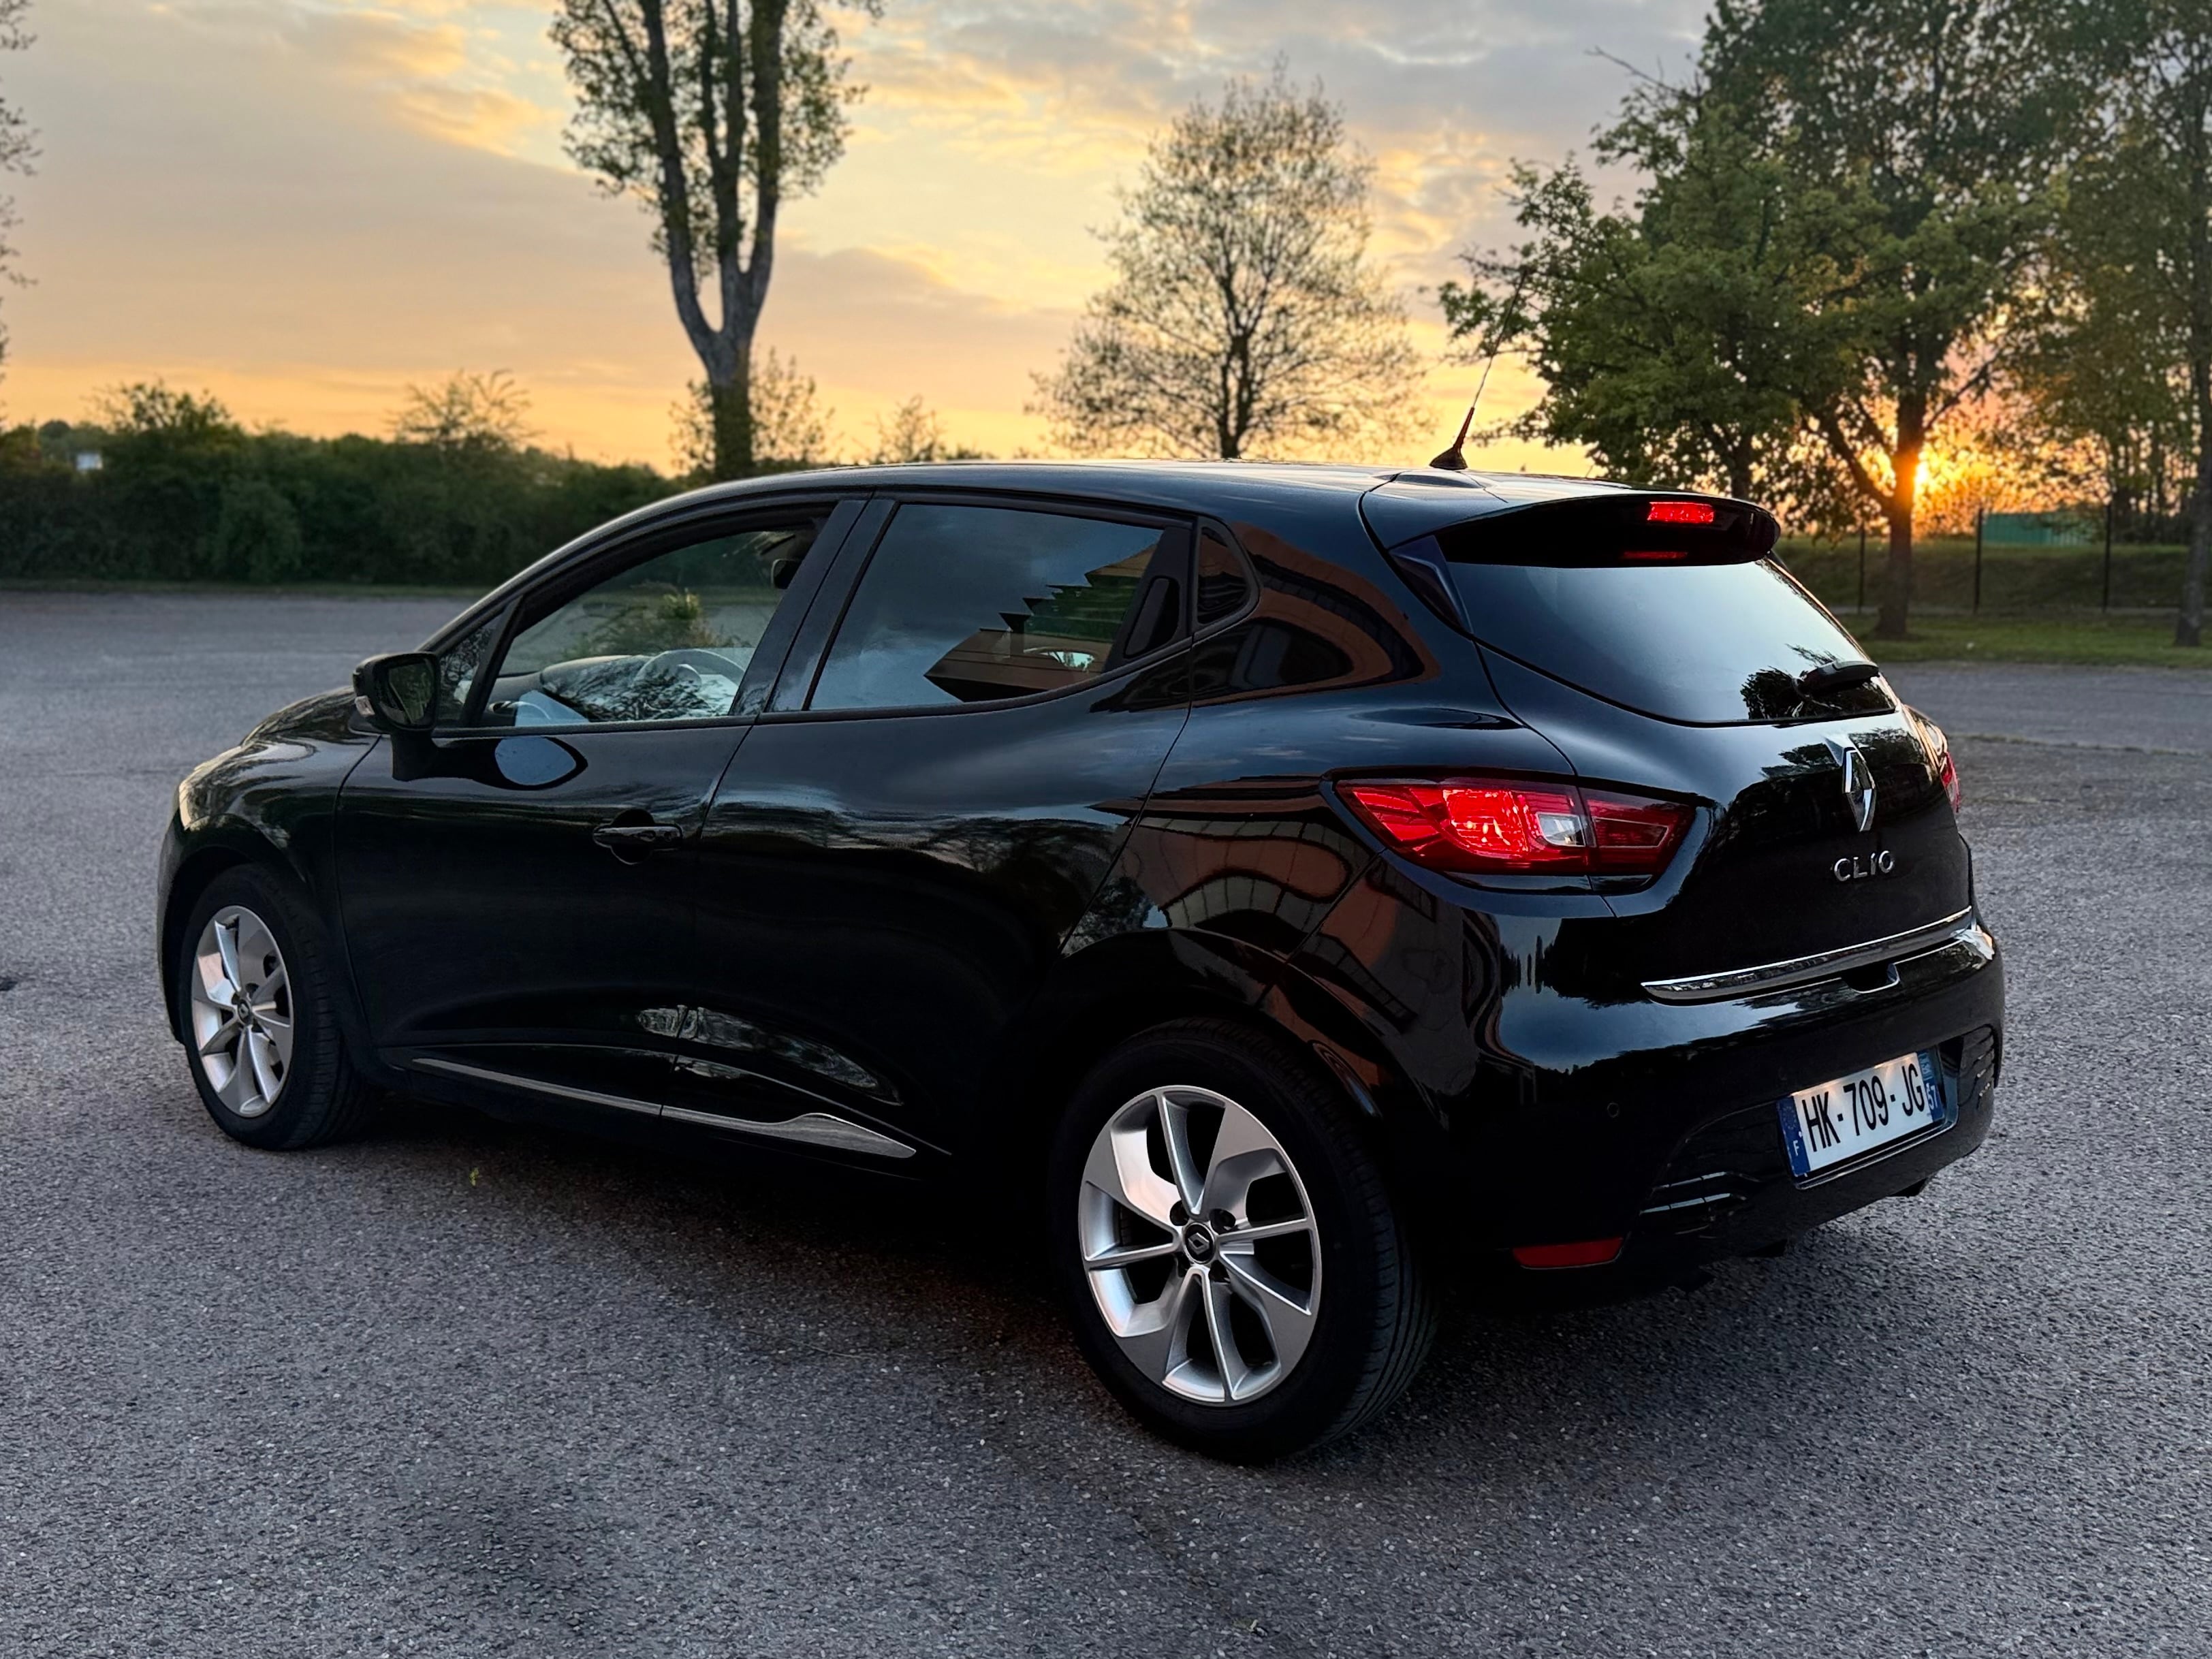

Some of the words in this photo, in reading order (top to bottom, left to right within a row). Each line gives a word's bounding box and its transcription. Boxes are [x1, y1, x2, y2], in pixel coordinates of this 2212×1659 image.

[1834, 851, 1893, 881] CLIO
[1801, 1063, 1925, 1152] HK-709-JG
[1926, 1084, 1938, 1110] 57
[1792, 1139, 1800, 1156] F
